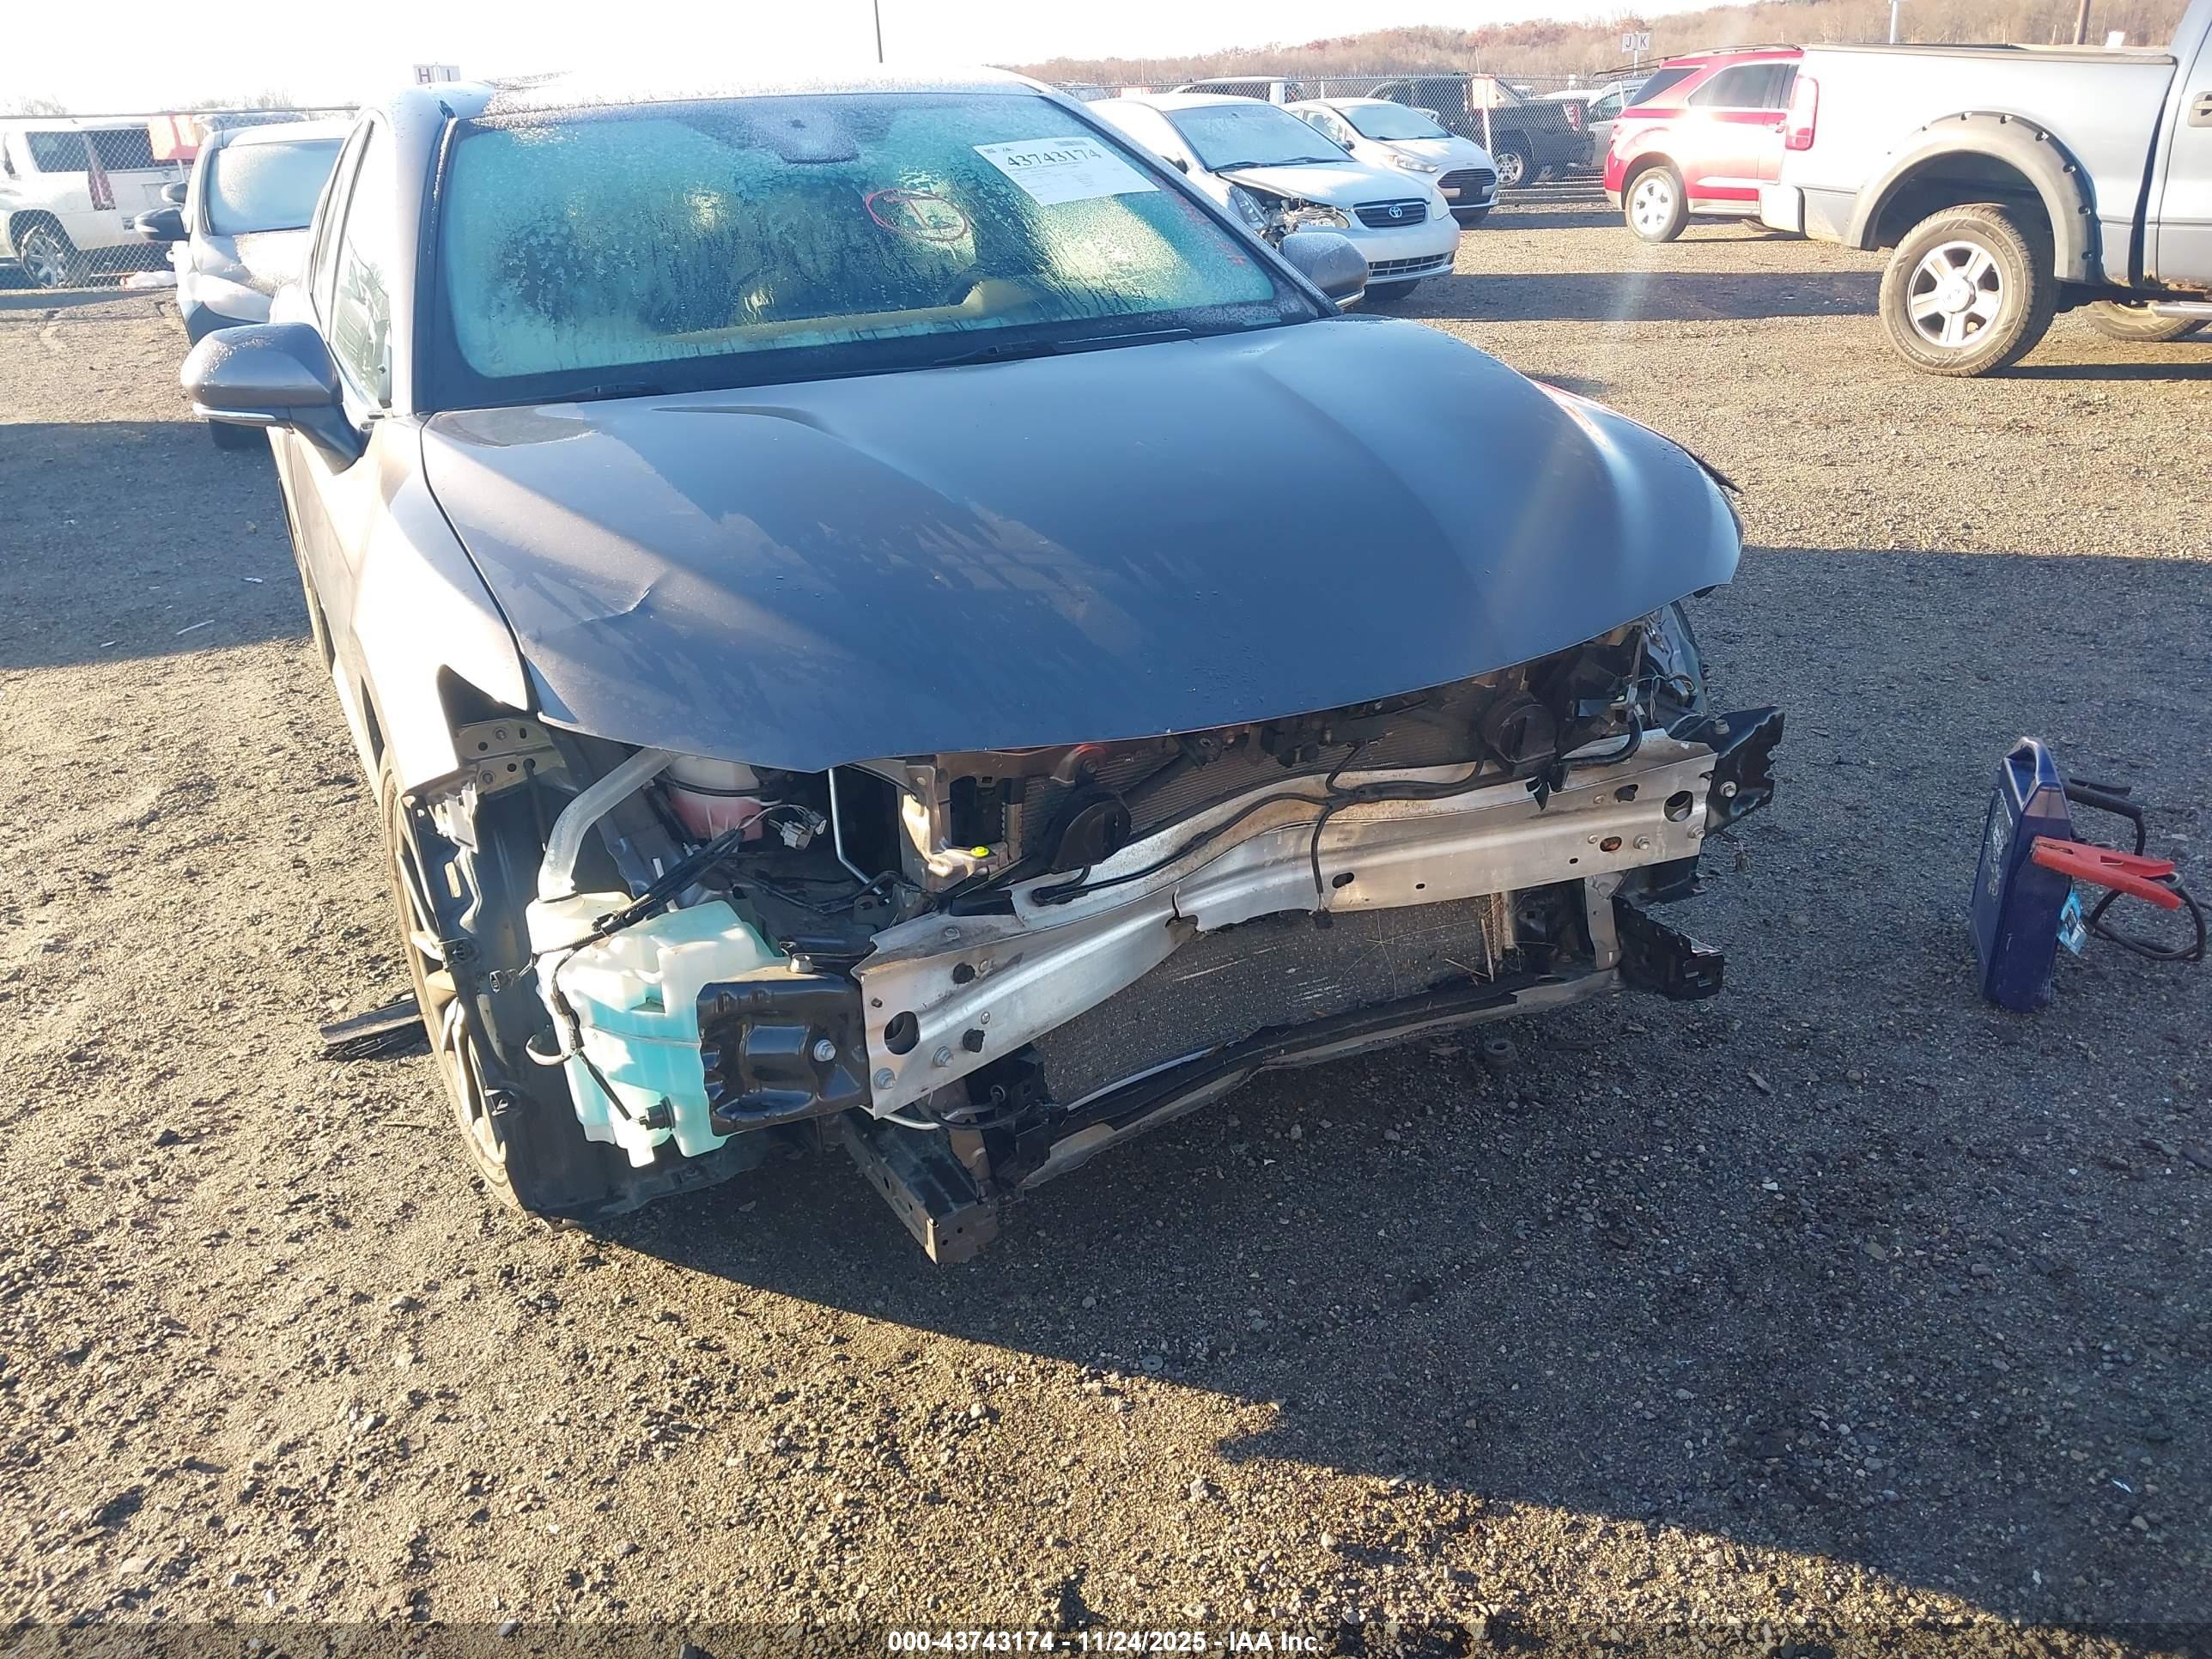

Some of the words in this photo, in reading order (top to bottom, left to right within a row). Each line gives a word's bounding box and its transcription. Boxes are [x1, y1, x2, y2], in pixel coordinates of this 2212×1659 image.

[1626, 36, 1632, 48] J
[1640, 36, 1647, 48] K
[418, 68, 431, 83] H
[1007, 149, 1103, 167] 43743174
